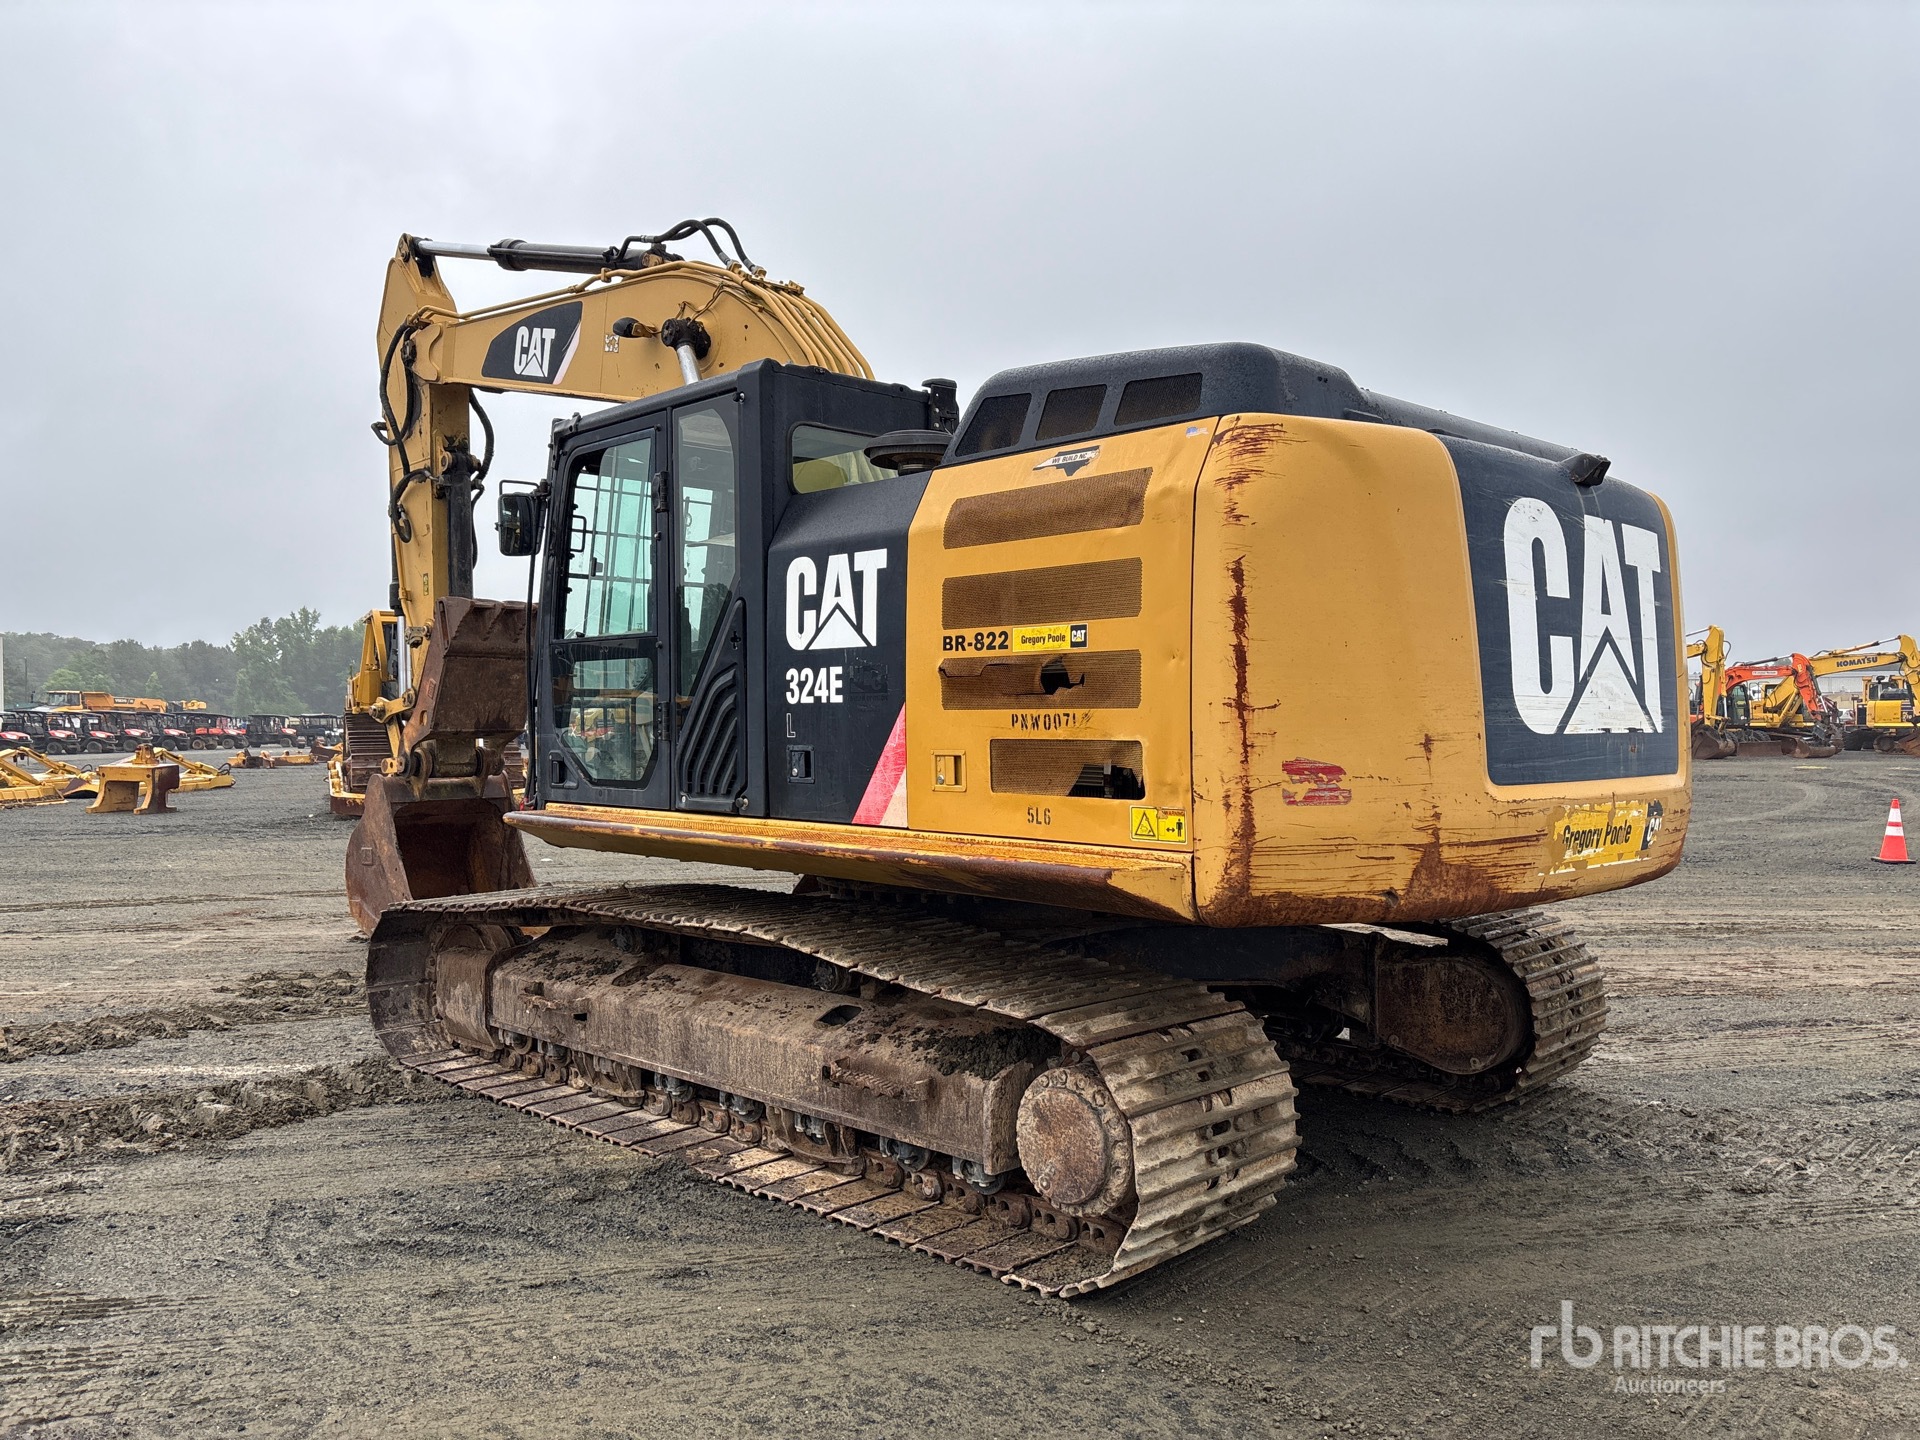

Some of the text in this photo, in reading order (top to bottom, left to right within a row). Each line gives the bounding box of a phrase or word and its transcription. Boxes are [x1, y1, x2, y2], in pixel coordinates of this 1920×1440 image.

[514, 326, 556, 377] CAT
[1062, 454, 1078, 463] BUILD
[786, 548, 887, 650] CAT
[1504, 497, 1663, 735] CAT
[943, 631, 1009, 651] BR-822
[1021, 633, 1066, 645] Gregory Poole
[1071, 629, 1086, 642] CAT
[1836, 656, 1878, 668] KOMATSU
[786, 666, 843, 704] 324E
[786, 713, 796, 738] L
[1563, 825, 1603, 854] Gregory
